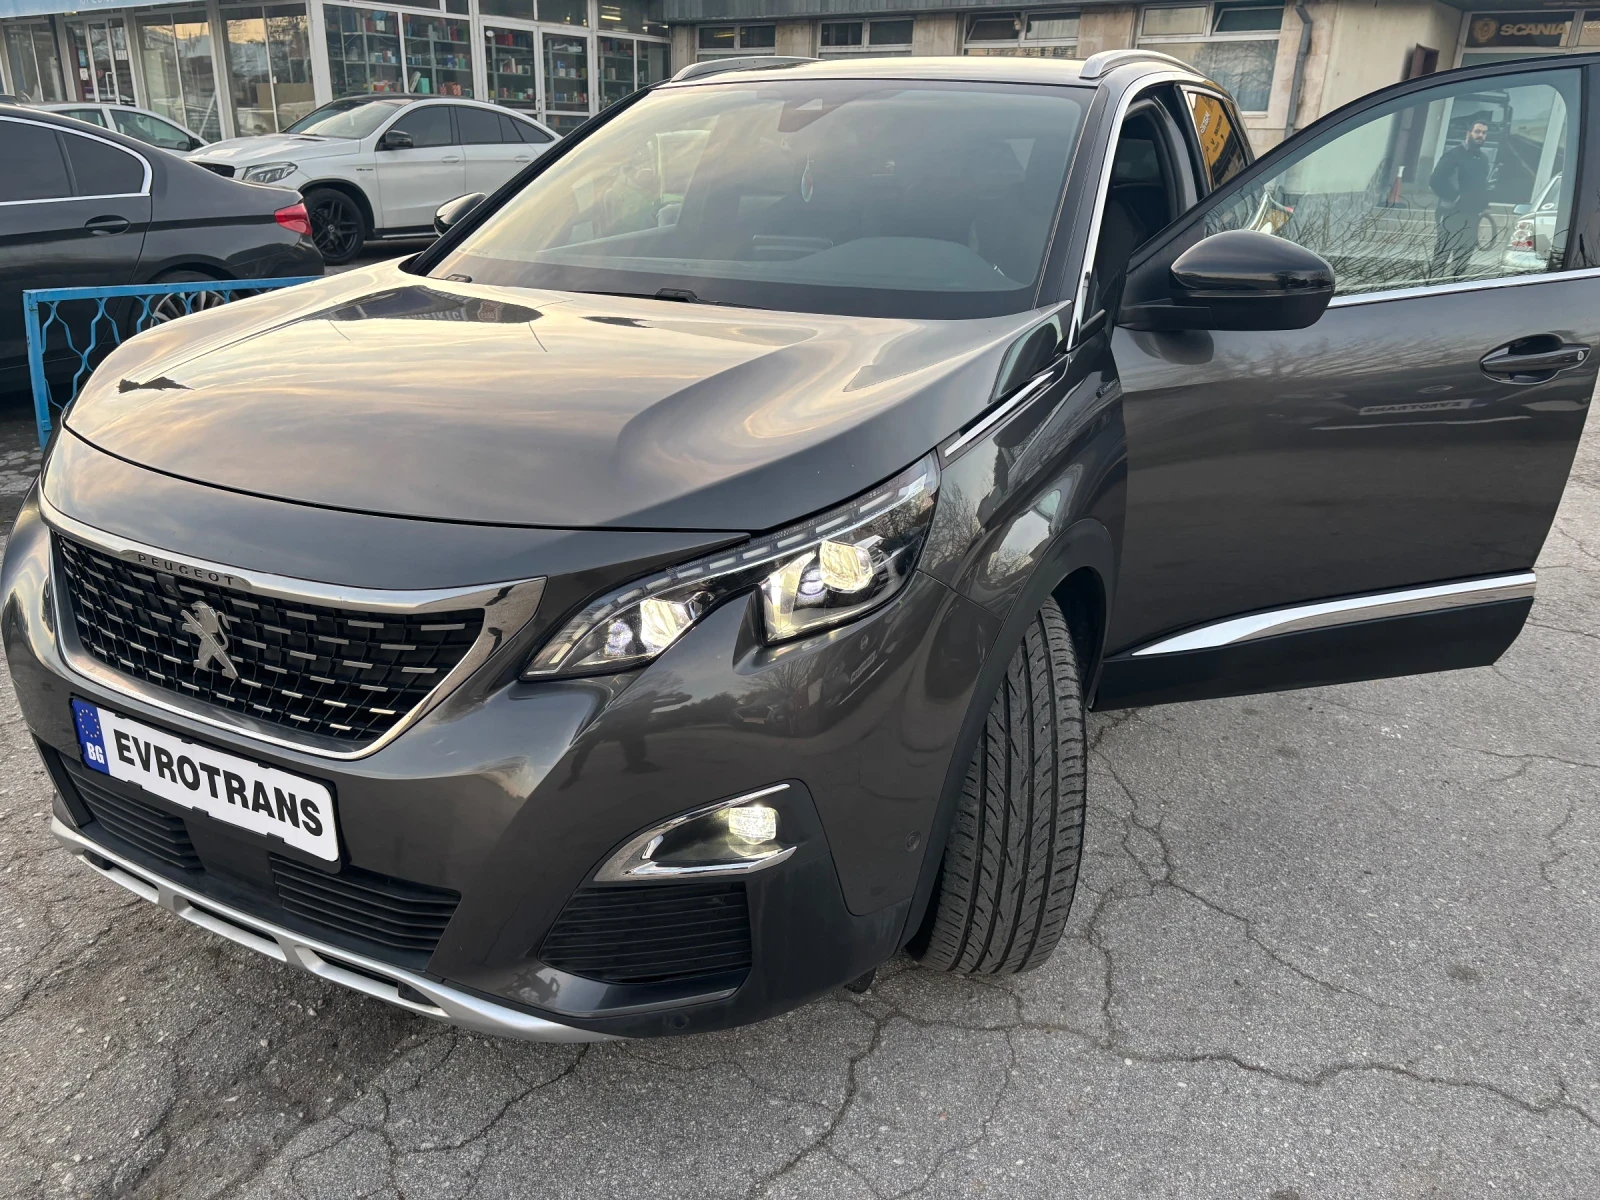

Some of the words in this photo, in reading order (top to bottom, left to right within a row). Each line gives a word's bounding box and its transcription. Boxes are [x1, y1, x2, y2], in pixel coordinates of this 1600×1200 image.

[1500, 23, 1568, 36] SCANIA
[137, 553, 234, 586] PEUGEOT
[86, 741, 105, 765] BG
[113, 728, 324, 837] EVROTRANS
